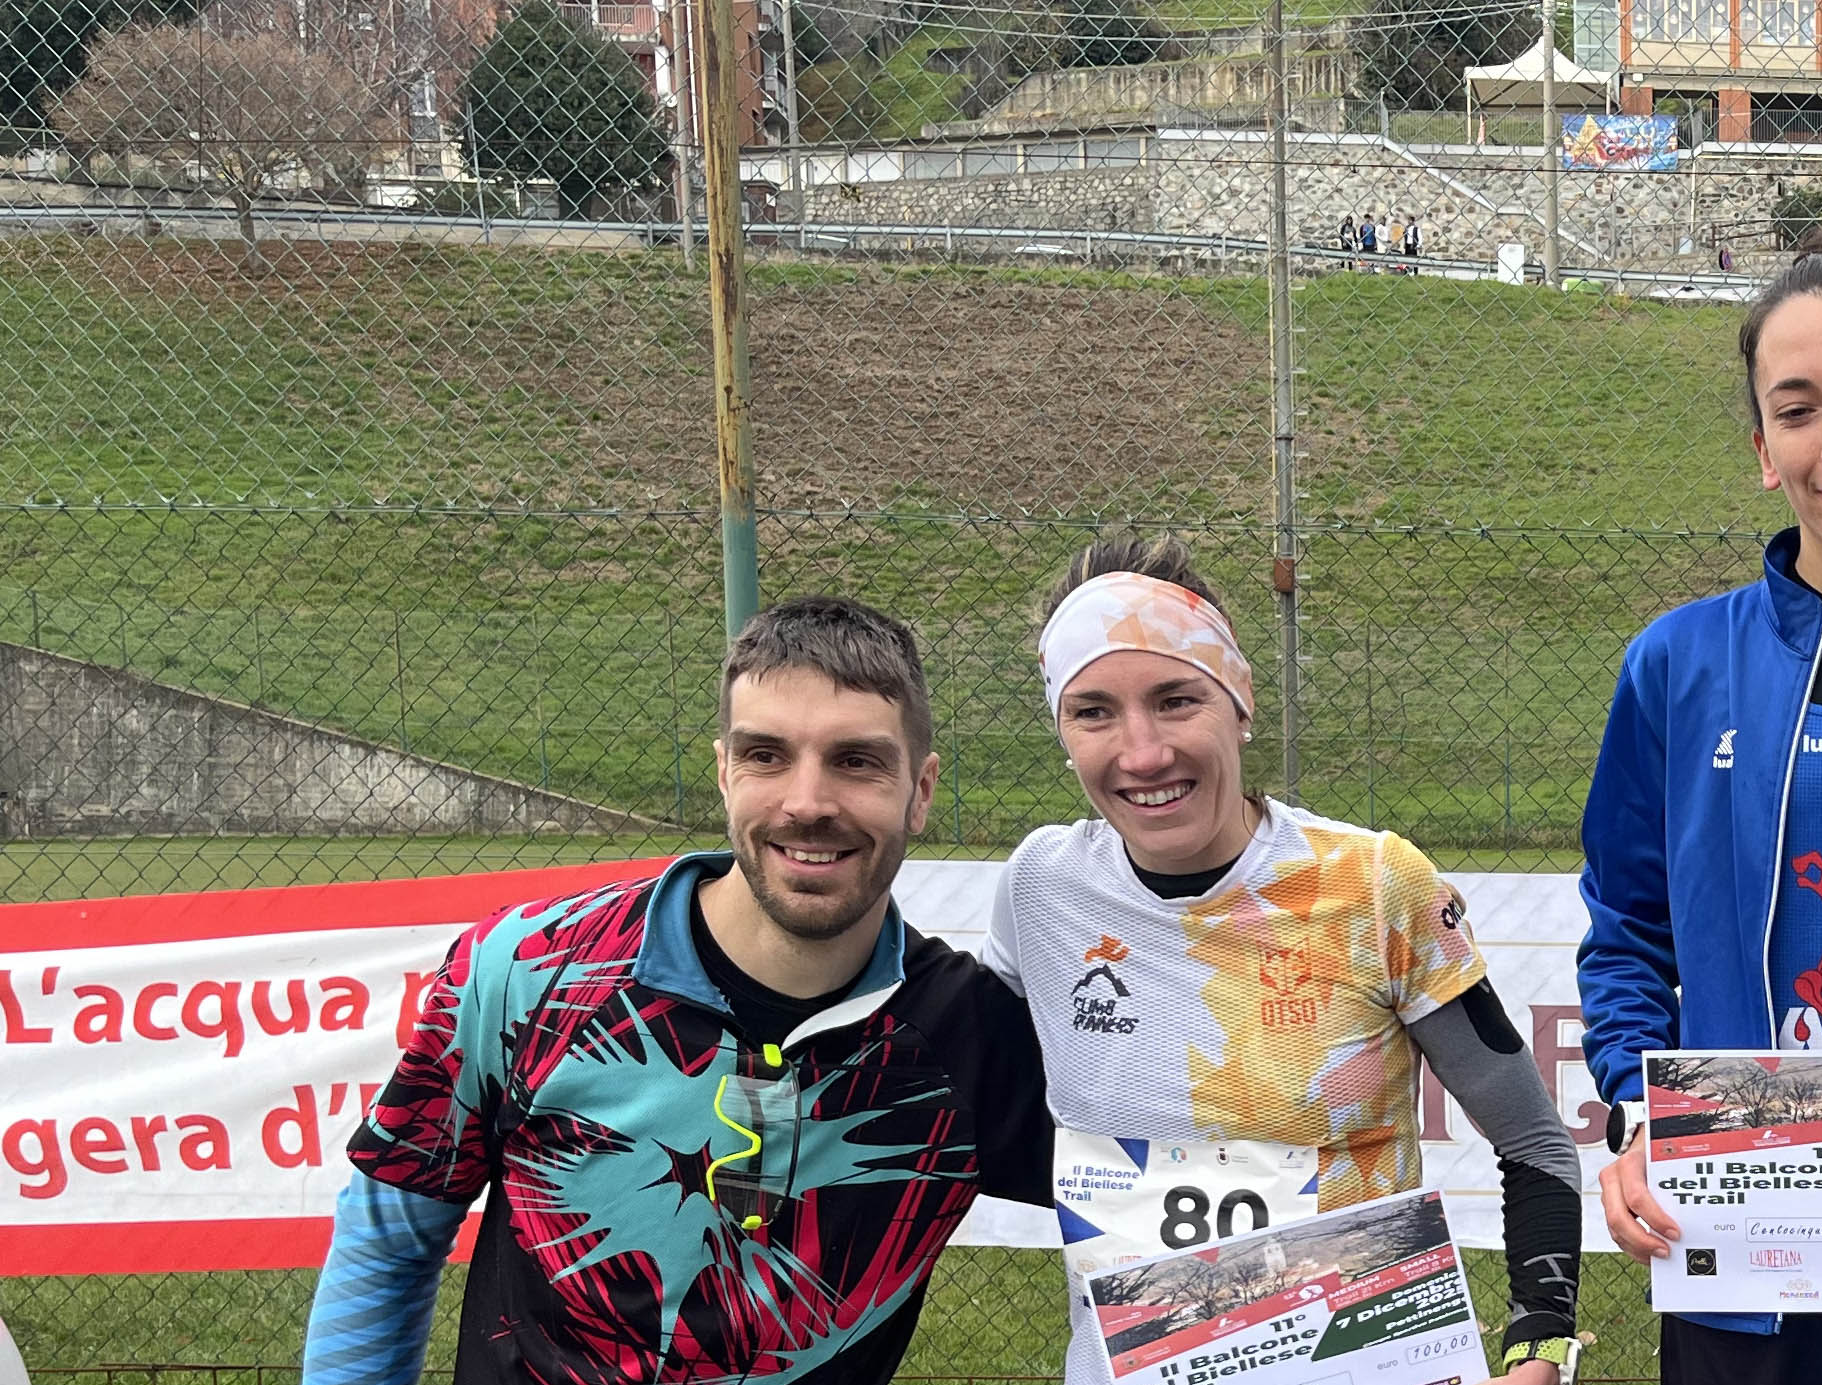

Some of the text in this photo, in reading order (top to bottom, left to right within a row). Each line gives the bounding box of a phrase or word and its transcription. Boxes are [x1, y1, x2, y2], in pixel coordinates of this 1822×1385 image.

[0, 966, 371, 1058] L'acqua
[1261, 1000, 1317, 1025] OTSO
[2, 1113, 232, 1200] gera
[1085, 1166, 1140, 1180] Balcone
[1695, 1162, 1713, 1174] Il
[1058, 1177, 1134, 1191] del Biellese
[1658, 1177, 1707, 1190] del
[1063, 1190, 1092, 1202] Trail
[1673, 1191, 1745, 1205] Trail
[1160, 1185, 1270, 1251] 80
[1714, 1223, 1736, 1232] euro
[1400, 1253, 1441, 1273] SMALL
[1328, 1275, 1380, 1299] MEDIUM
[1392, 1271, 1459, 1300] Domenic
[1270, 1314, 1306, 1332] 11°
[1335, 1316, 1351, 1329] 7
[1160, 1363, 1179, 1378] Il
[1189, 1329, 1319, 1370] Balcone
[1377, 1334, 1468, 1371] euro 100,00
[1187, 1345, 1313, 1385] Biellese
